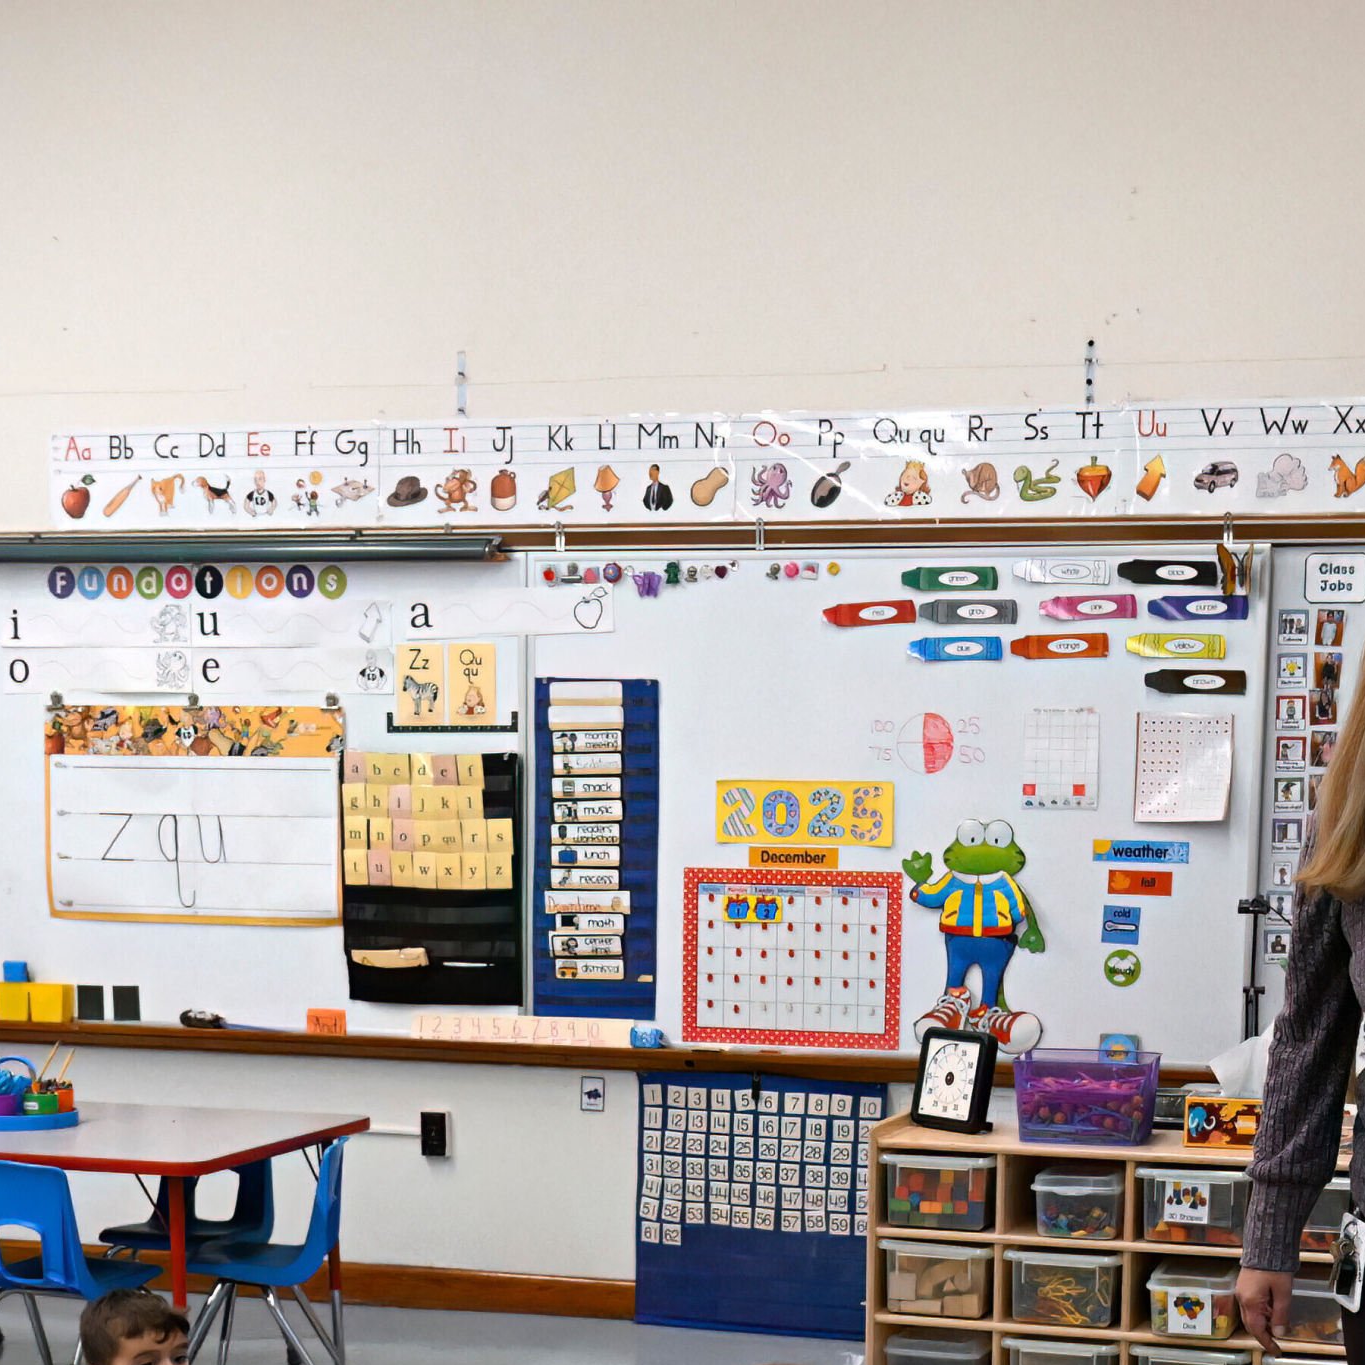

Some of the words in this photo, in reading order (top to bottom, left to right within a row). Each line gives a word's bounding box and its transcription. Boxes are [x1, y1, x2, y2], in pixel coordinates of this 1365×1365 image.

[64, 435, 92, 462] Aa
[108, 434, 135, 460] Bb
[153, 433, 180, 459] Cc
[198, 431, 227, 458] Dd
[246, 431, 272, 457] Ee
[294, 429, 318, 456] Ff
[334, 429, 369, 467] Gg
[392, 427, 422, 455] Hh
[442, 427, 466, 454] Ii
[492, 426, 515, 465] Jj
[547, 424, 574, 451] Kk
[638, 423, 679, 450] Mm
[695, 421, 726, 449] Nn
[751, 420, 791, 447] Oo
[817, 418, 845, 459] Pp
[872, 417, 911, 445] Qu
[918, 427, 946, 456] qu
[967, 415, 994, 443] Rr
[1023, 412, 1049, 441] Ss
[1075, 411, 1105, 440] Tt
[1137, 408, 1168, 438] Uu
[1200, 407, 1235, 437] Vv
[1259, 406, 1309, 435] Ww
[1318, 562, 1356, 576] Class
[54, 570, 339, 596] Fundations
[1319, 579, 1354, 593] Jobs
[196, 610, 222, 637] u
[409, 601, 434, 629] a
[10, 608, 22, 641] i
[408, 648, 430, 671] Zz
[459, 648, 483, 667] Qu
[9, 658, 31, 683] o
[200, 657, 222, 683] e
[462, 666, 479, 686] qu
[868, 718, 895, 734] 100
[956, 716, 981, 735] 25
[868, 745, 893, 762] 75
[957, 744, 986, 764] 50
[351, 764, 360, 774] a
[372, 763, 382, 776] b
[393, 766, 401, 776] c
[417, 764, 427, 777] d
[440, 767, 449, 778] e
[467, 764, 474, 777] f
[582, 781, 613, 793] snack
[349, 796, 359, 809] g
[441, 796, 451, 809] k
[583, 805, 613, 816] music
[721, 785, 884, 842] 2025
[97, 811, 136, 863] z
[349, 829, 362, 840] m
[376, 831, 385, 841] n
[399, 832, 408, 842] o
[421, 834, 432, 846] p
[441, 835, 457, 845] qu
[470, 831, 478, 842] r
[496, 832, 505, 842] s
[583, 850, 611, 861] lunch
[759, 849, 827, 866] December
[1112, 843, 1170, 859] weather
[375, 863, 384, 873] u
[398, 864, 406, 874] v
[418, 865, 431, 876] w
[443, 866, 453, 876] x
[469, 866, 478, 880] y
[495, 866, 504, 876] z
[578, 874, 614, 885] recess
[1140, 876, 1157, 888] fall
[735, 906, 742, 918] 1
[763, 908, 770, 919] 2
[1112, 908, 1132, 919] cold
[587, 917, 615, 928] math
[583, 937, 614, 946] center
[1108, 965, 1136, 977] cloudy
[418, 1015, 424, 1033] 1
[432, 1015, 443, 1033] 2
[452, 1017, 462, 1034] 3
[471, 1016, 482, 1034] 4
[492, 1017, 501, 1034] 5
[513, 1019, 522, 1035] 6
[533, 1018, 543, 1037] 7
[550, 1020, 559, 1036] 8
[567, 1021, 576, 1037] 9
[587, 1022, 600, 1038] 10
[651, 1089, 656, 1103] 1
[673, 1090, 681, 1104] 2
[693, 1092, 702, 1106] 3
[715, 1092, 724, 1106] 4
[741, 1093, 750, 1108] 5
[764, 1096, 773, 1109] 6
[791, 1096, 800, 1111] 7
[814, 1098, 823, 1112] 8
[837, 1099, 846, 1112] 9
[862, 1101, 877, 1115] 10
[648, 1110, 658, 1124] 11
[671, 1113, 683, 1127] 12
[691, 1114, 704, 1128] 13
[713, 1116, 726, 1129] 14
[737, 1117, 749, 1131] 15
